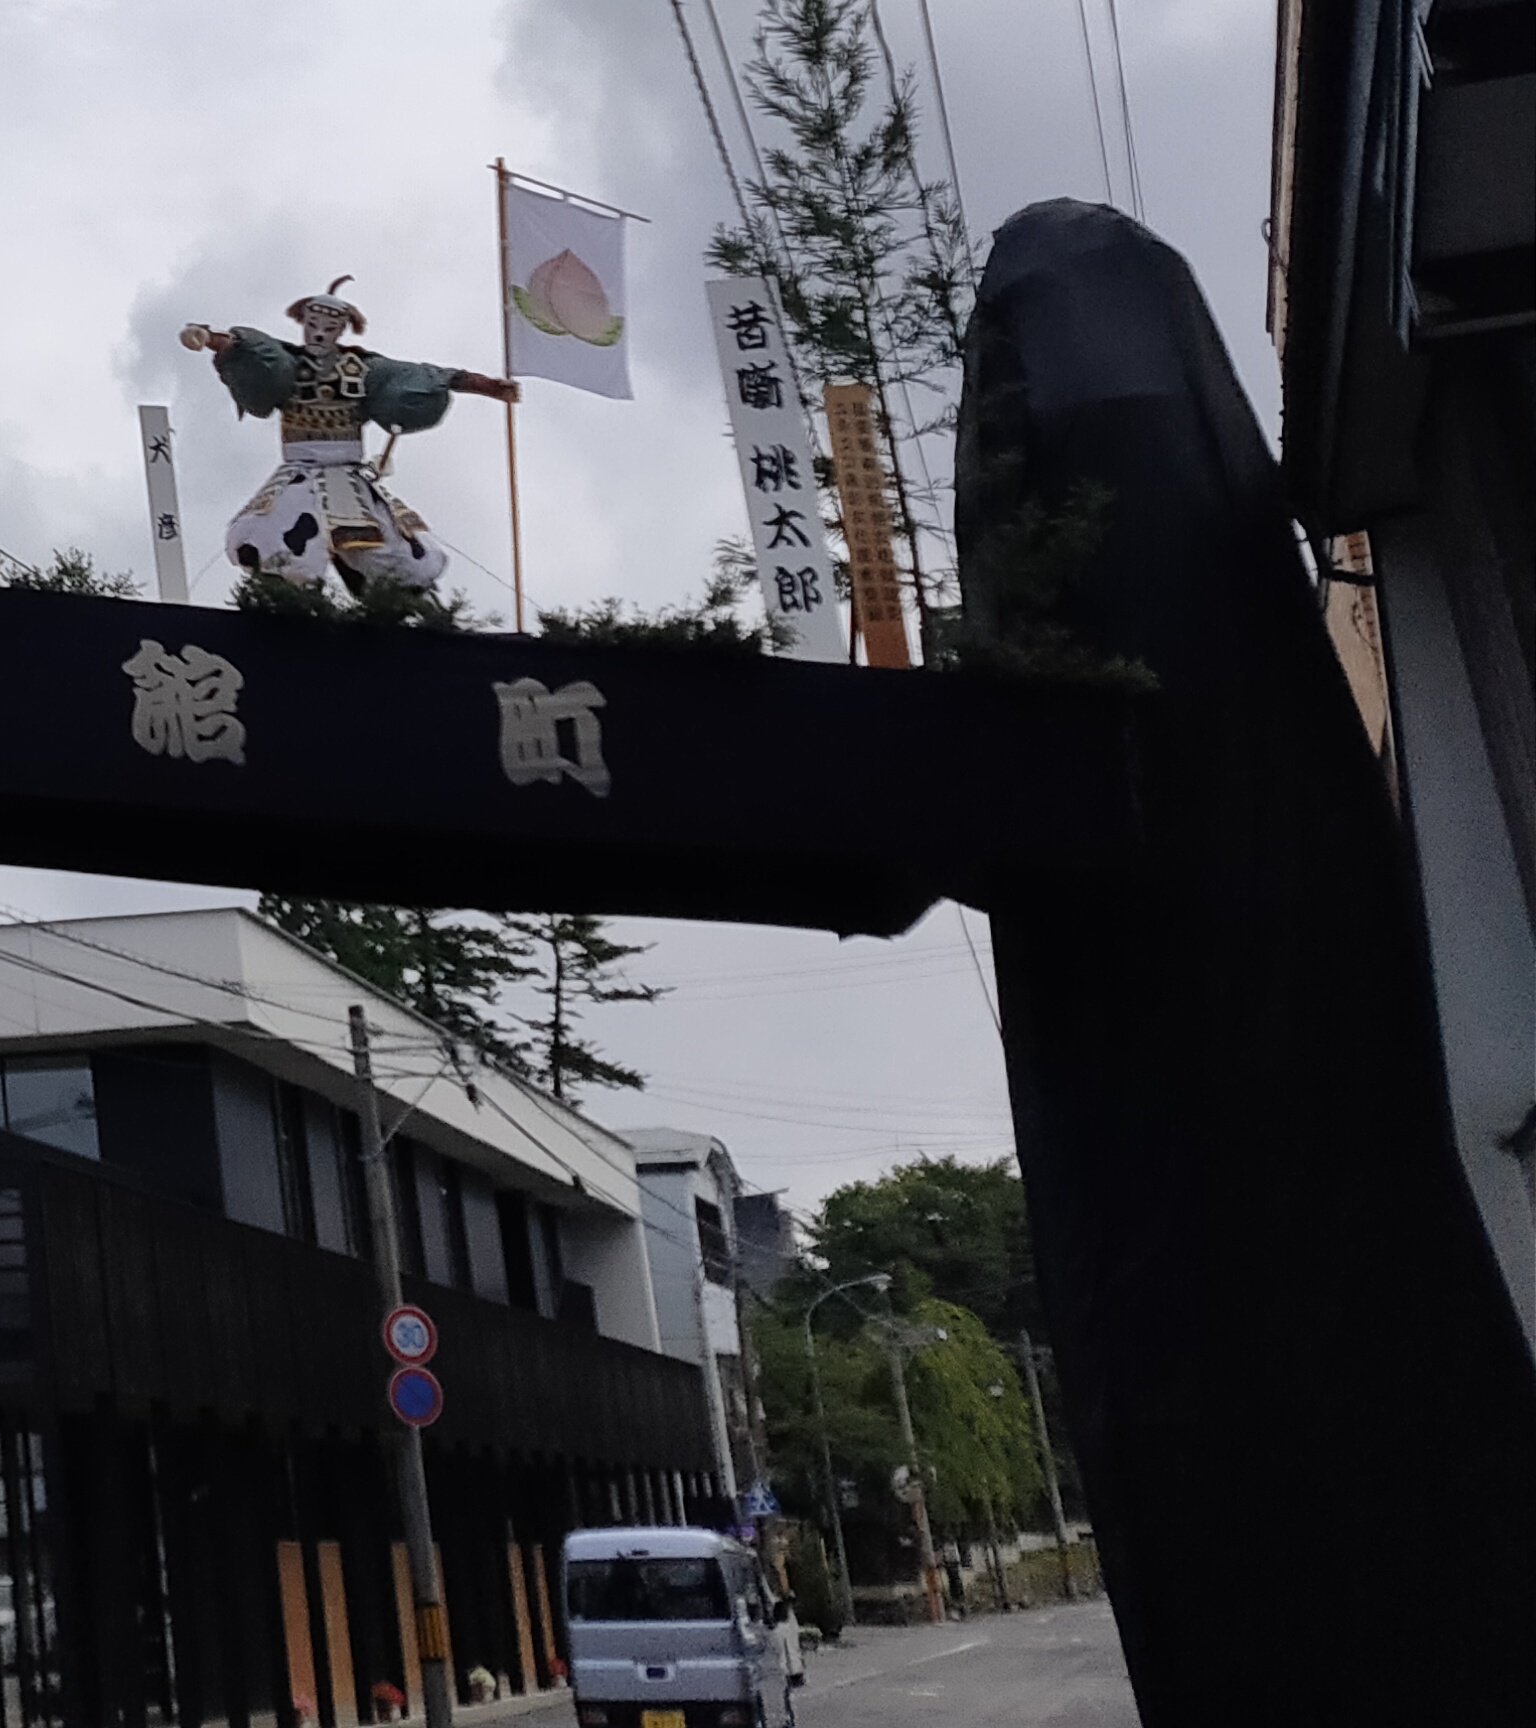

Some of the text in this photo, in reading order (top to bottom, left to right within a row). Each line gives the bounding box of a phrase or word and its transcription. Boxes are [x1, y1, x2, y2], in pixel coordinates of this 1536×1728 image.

[148, 434, 179, 541] 犬彦
[749, 444, 824, 613] 桃太郎
[396, 1322, 425, 1349] 30
